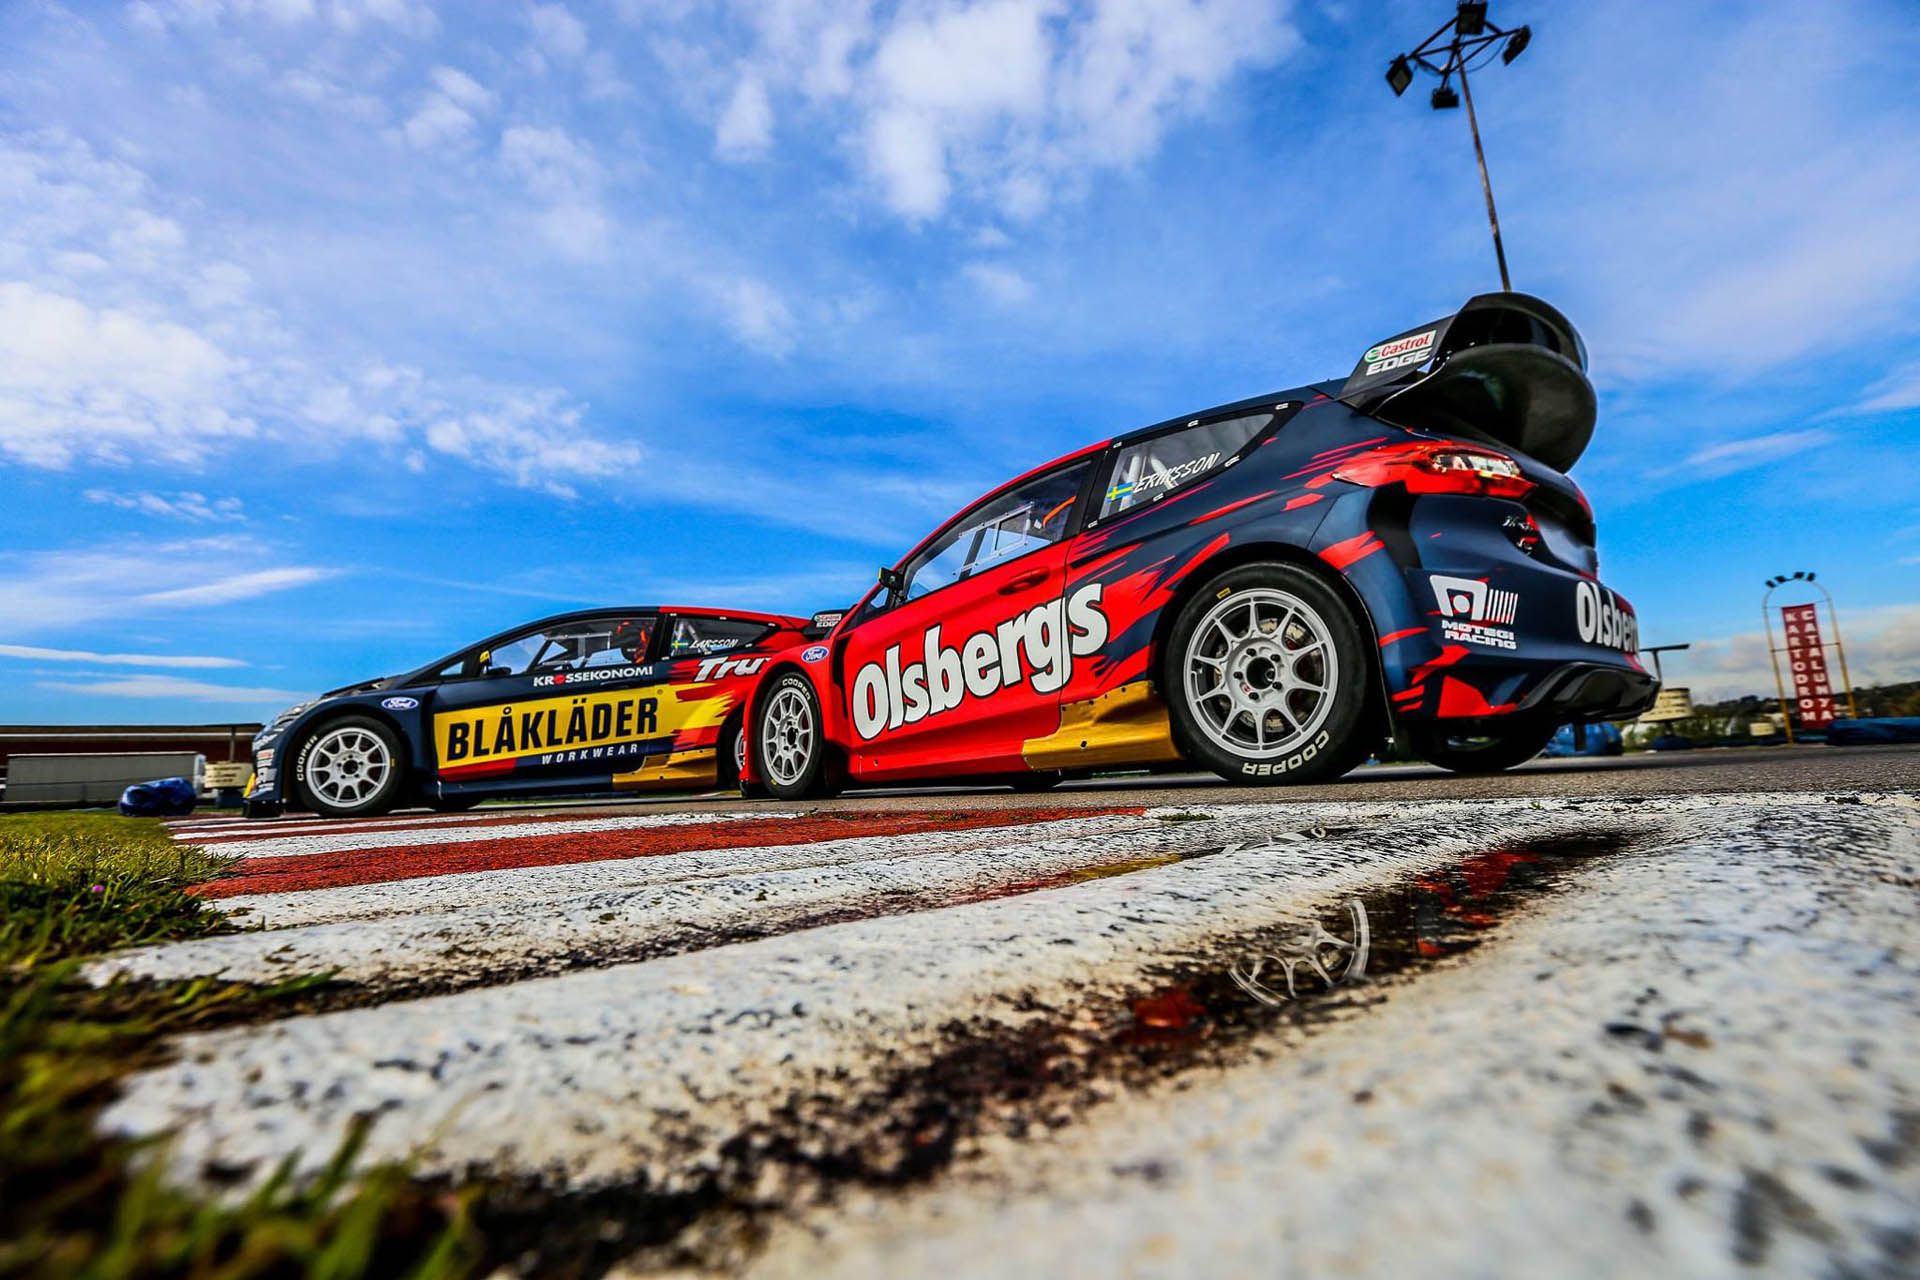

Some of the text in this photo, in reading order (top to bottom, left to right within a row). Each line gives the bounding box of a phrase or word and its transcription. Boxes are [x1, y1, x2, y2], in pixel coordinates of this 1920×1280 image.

[1381, 334, 1431, 357] Castrol
[1366, 347, 1433, 376] EDGE
[1133, 452, 1221, 493] ERIKSSON
[1441, 620, 1515, 640] MOTEGI
[1445, 630, 1517, 649] RACING
[689, 638, 739, 650] LARSSON
[804, 647, 826, 661] Ford
[694, 656, 771, 682] Tru
[852, 582, 1109, 740] Olsbergs
[1801, 610, 1833, 720] CATALUNYA
[782, 678, 812, 700] COOPER
[386, 698, 413, 709] Ford
[447, 697, 658, 762] BLÅKLÄDER
[297, 735, 318, 781] COOPER
[541, 744, 638, 765] WORKWEAR
[1242, 730, 1330, 776] COOPER
